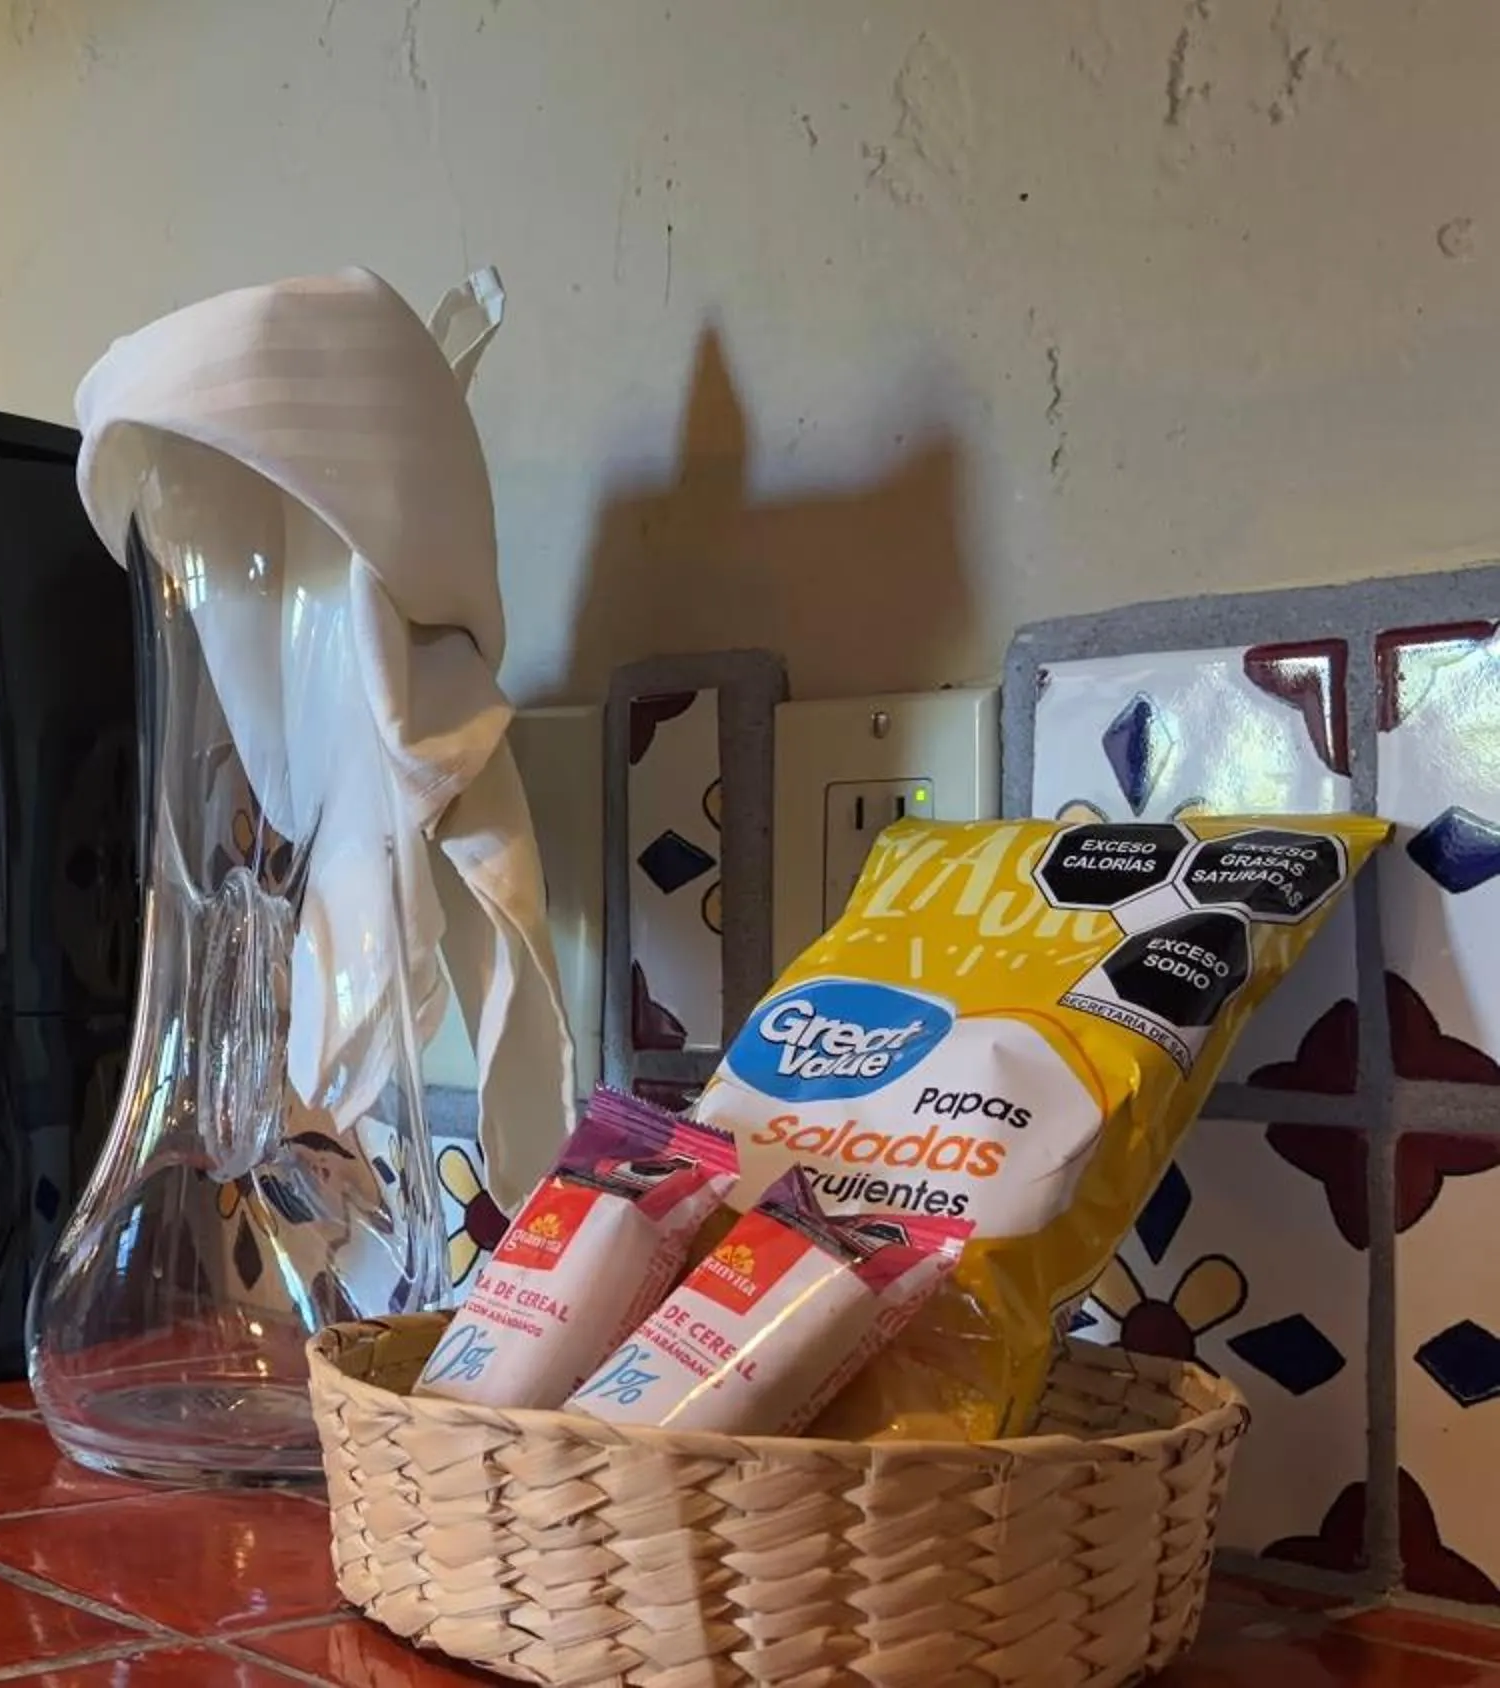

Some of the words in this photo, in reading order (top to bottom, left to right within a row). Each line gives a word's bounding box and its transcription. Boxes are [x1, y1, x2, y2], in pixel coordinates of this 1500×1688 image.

[1062, 854, 1157, 873] CALORÍAS
[1080, 839, 1157, 853] EXCESO
[1231, 843, 1318, 861] EXCESO
[1219, 853, 1306, 877] GRASAS
[1191, 868, 1304, 909] SATURADAS
[1142, 953, 1211, 990] SODIO
[1146, 938, 1231, 978] EXCESO
[759, 999, 924, 1056] Great
[1148, 1026, 1171, 1045] DE
[777, 1047, 891, 1080] Value
[913, 1086, 1033, 1130] Papas
[750, 1113, 1008, 1178] Saladas
[493, 1280, 517, 1300] DE
[516, 1289, 569, 1323] CEREAL
[663, 1304, 691, 1328] DE
